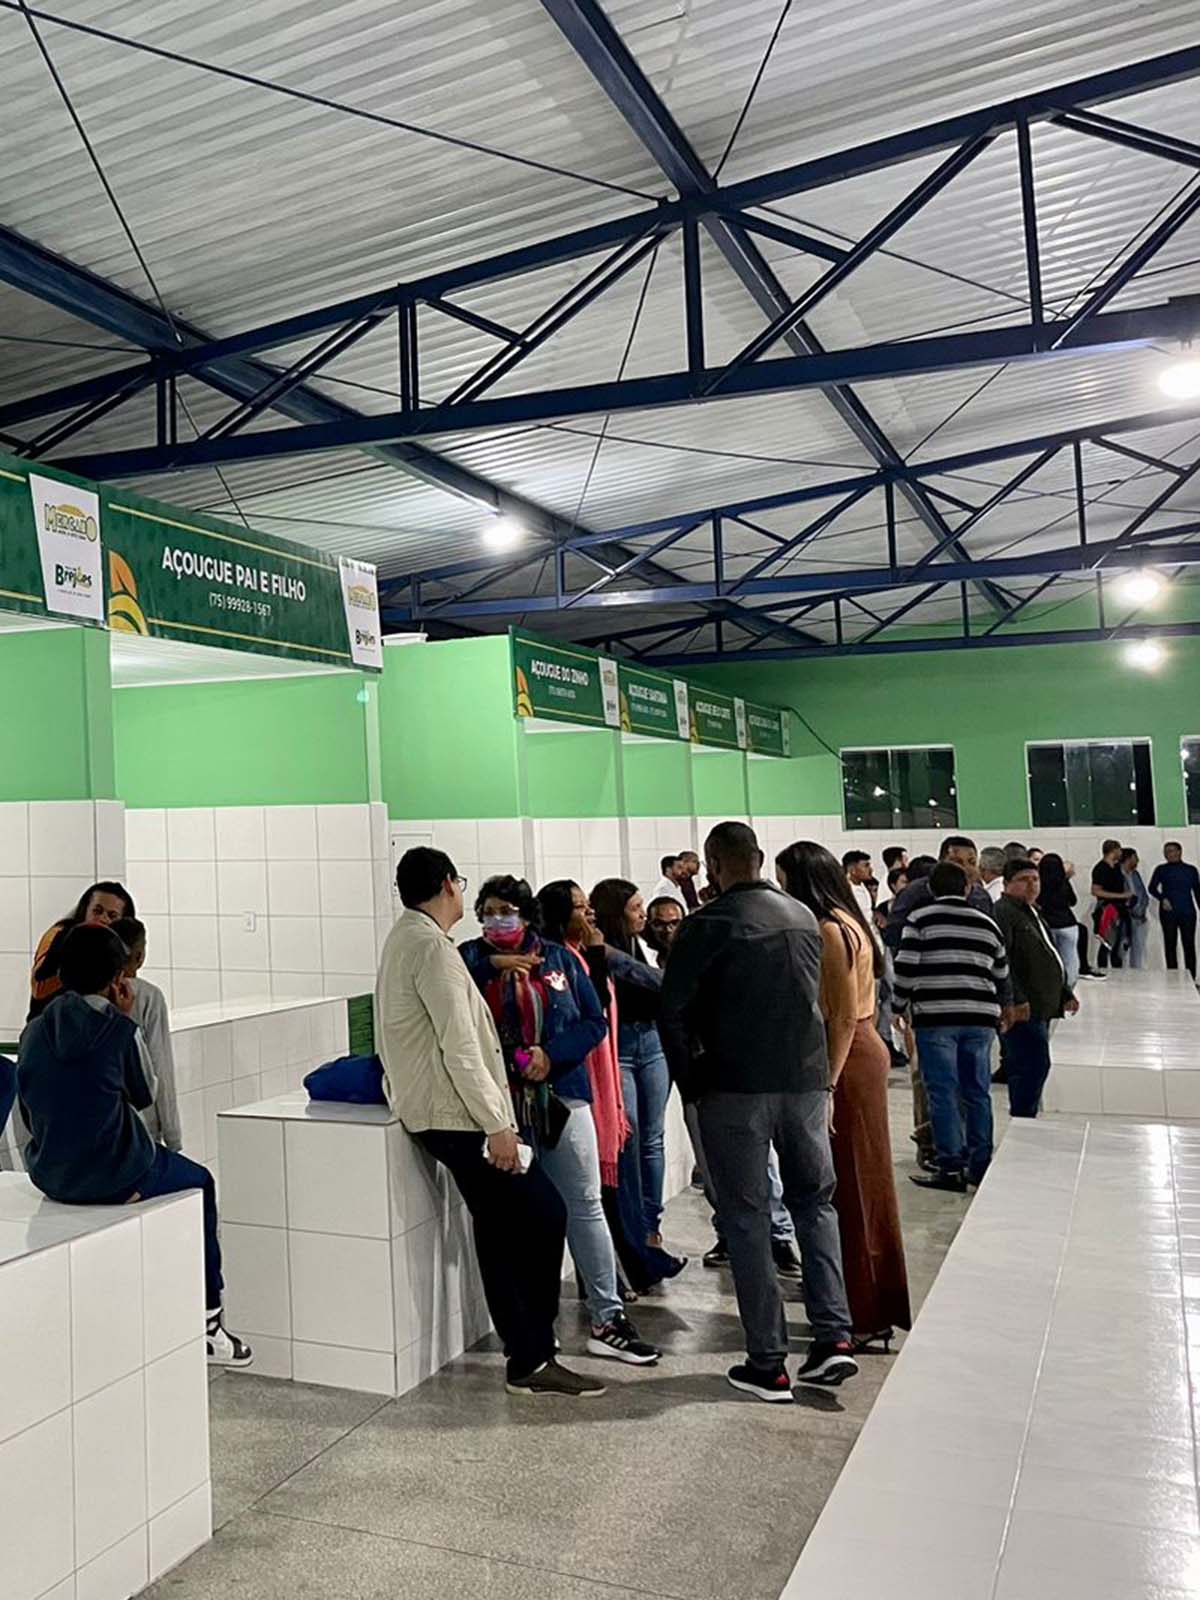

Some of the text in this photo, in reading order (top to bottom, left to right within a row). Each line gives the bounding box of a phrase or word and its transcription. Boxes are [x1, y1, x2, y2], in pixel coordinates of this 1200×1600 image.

[162, 546, 306, 602] AÇOUGUE PAI E FILHO
[209, 592, 226, 610] (75)
